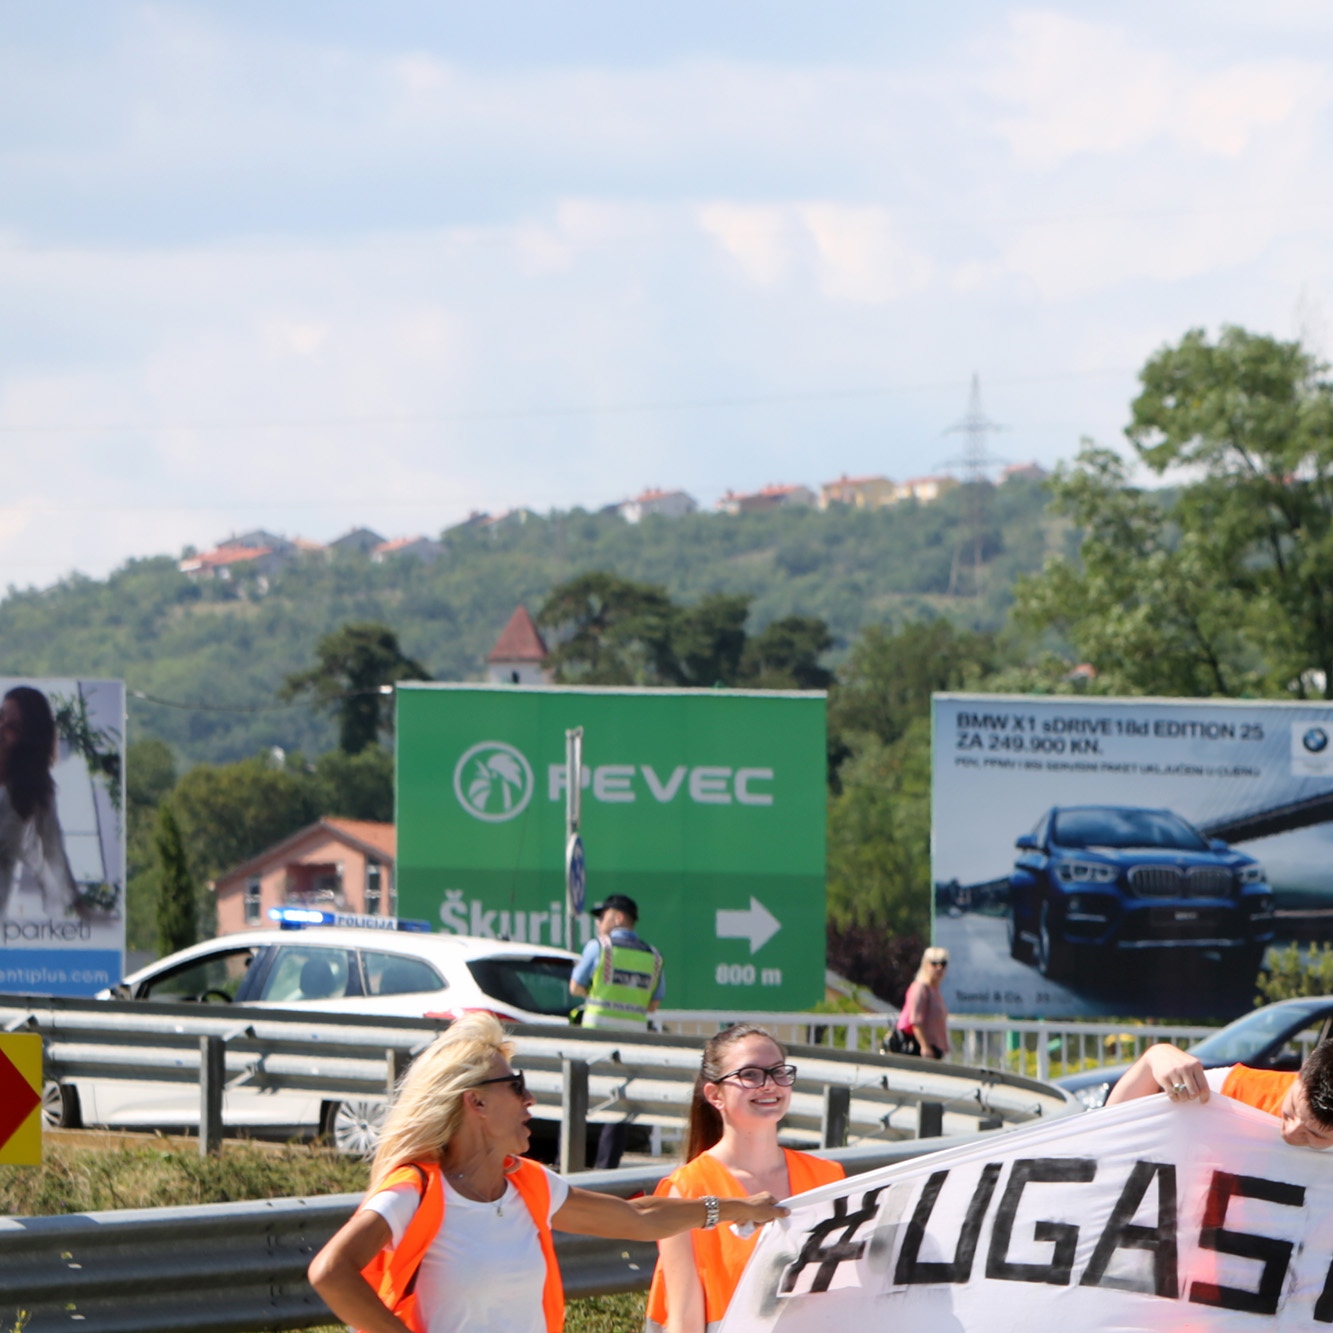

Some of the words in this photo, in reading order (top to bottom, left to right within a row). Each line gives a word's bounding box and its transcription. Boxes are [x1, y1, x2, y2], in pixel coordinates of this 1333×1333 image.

[956, 711, 1008, 731] BMW
[1012, 714, 1036, 732] X1
[1153, 720, 1235, 739] EDITION
[1240, 722, 1264, 741] 25
[956, 732, 983, 749] ZA
[988, 733, 1066, 754] 249.900
[548, 763, 774, 806] PEVEC
[337, 916, 394, 931] POLICIJA
[715, 964, 756, 985] 800
[761, 967, 783, 986] m
